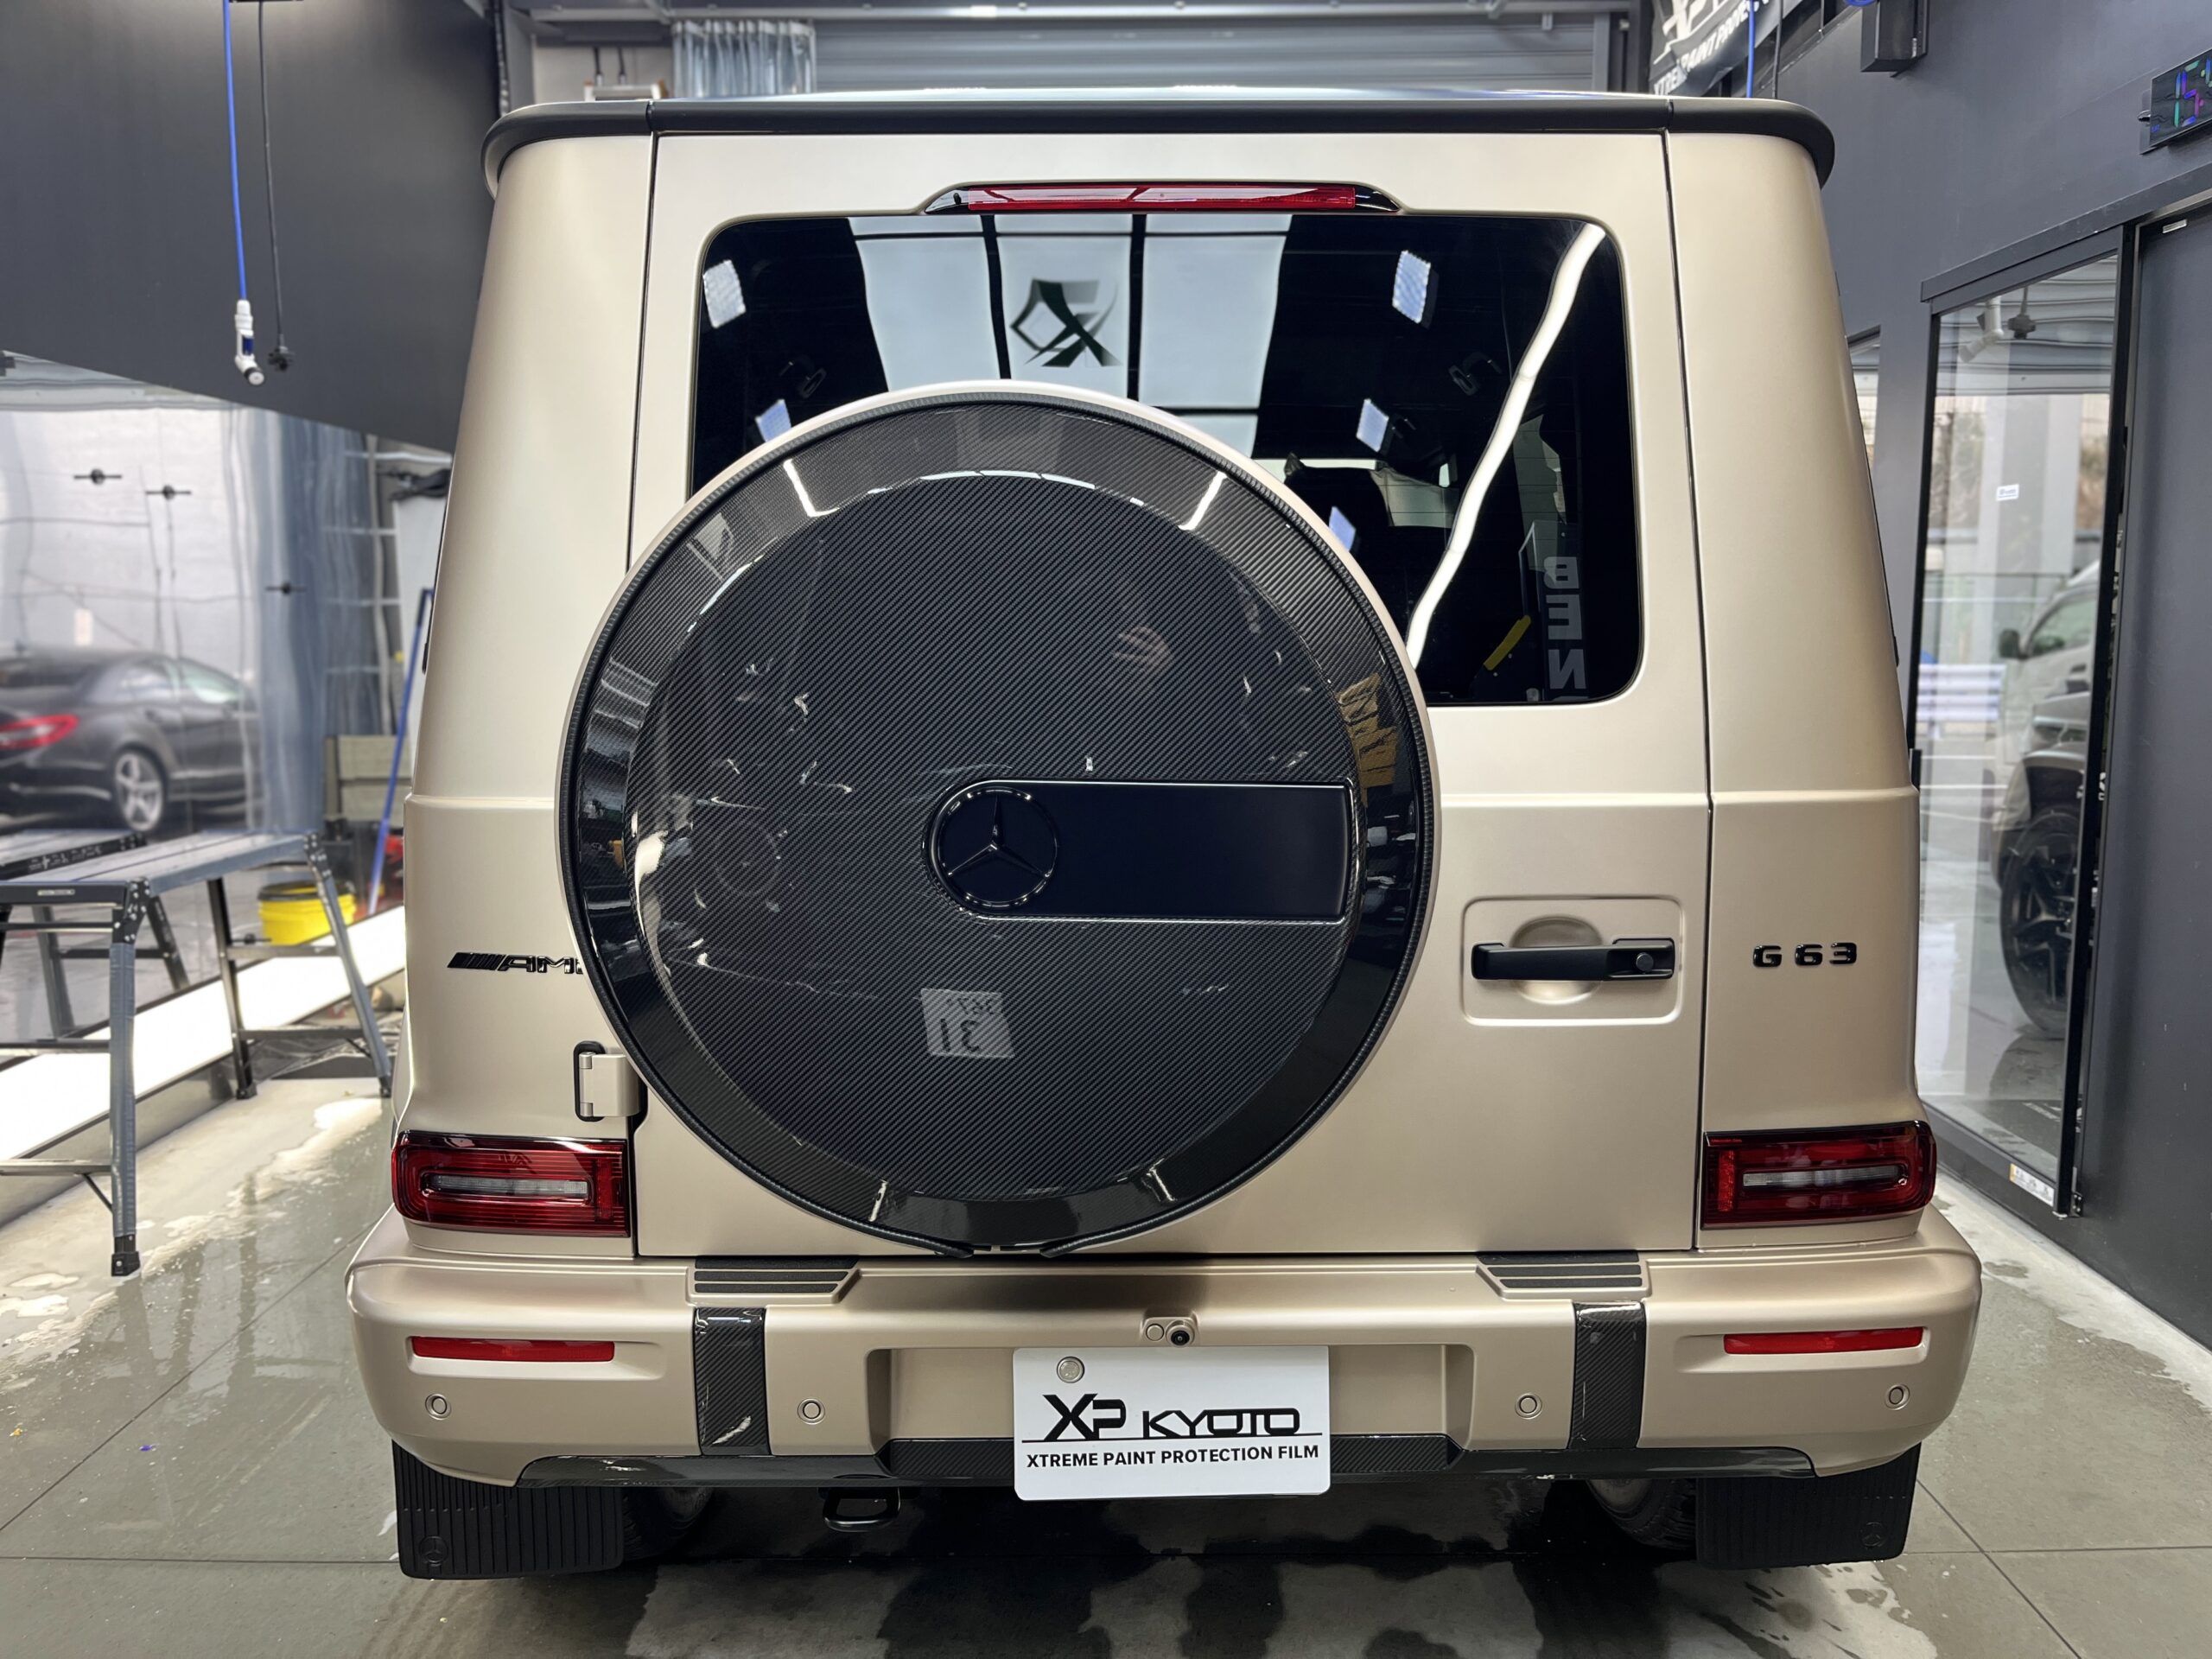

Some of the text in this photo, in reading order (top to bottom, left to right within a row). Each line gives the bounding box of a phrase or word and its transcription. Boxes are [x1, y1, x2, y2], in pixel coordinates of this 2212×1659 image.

[498, 955, 584, 974] AM
[1753, 943, 1857, 967] G 63
[1042, 1393, 1300, 1440] XP KYOTO
[1027, 1445, 1319, 1468] XTREME PAINT PROTECTION FILM
